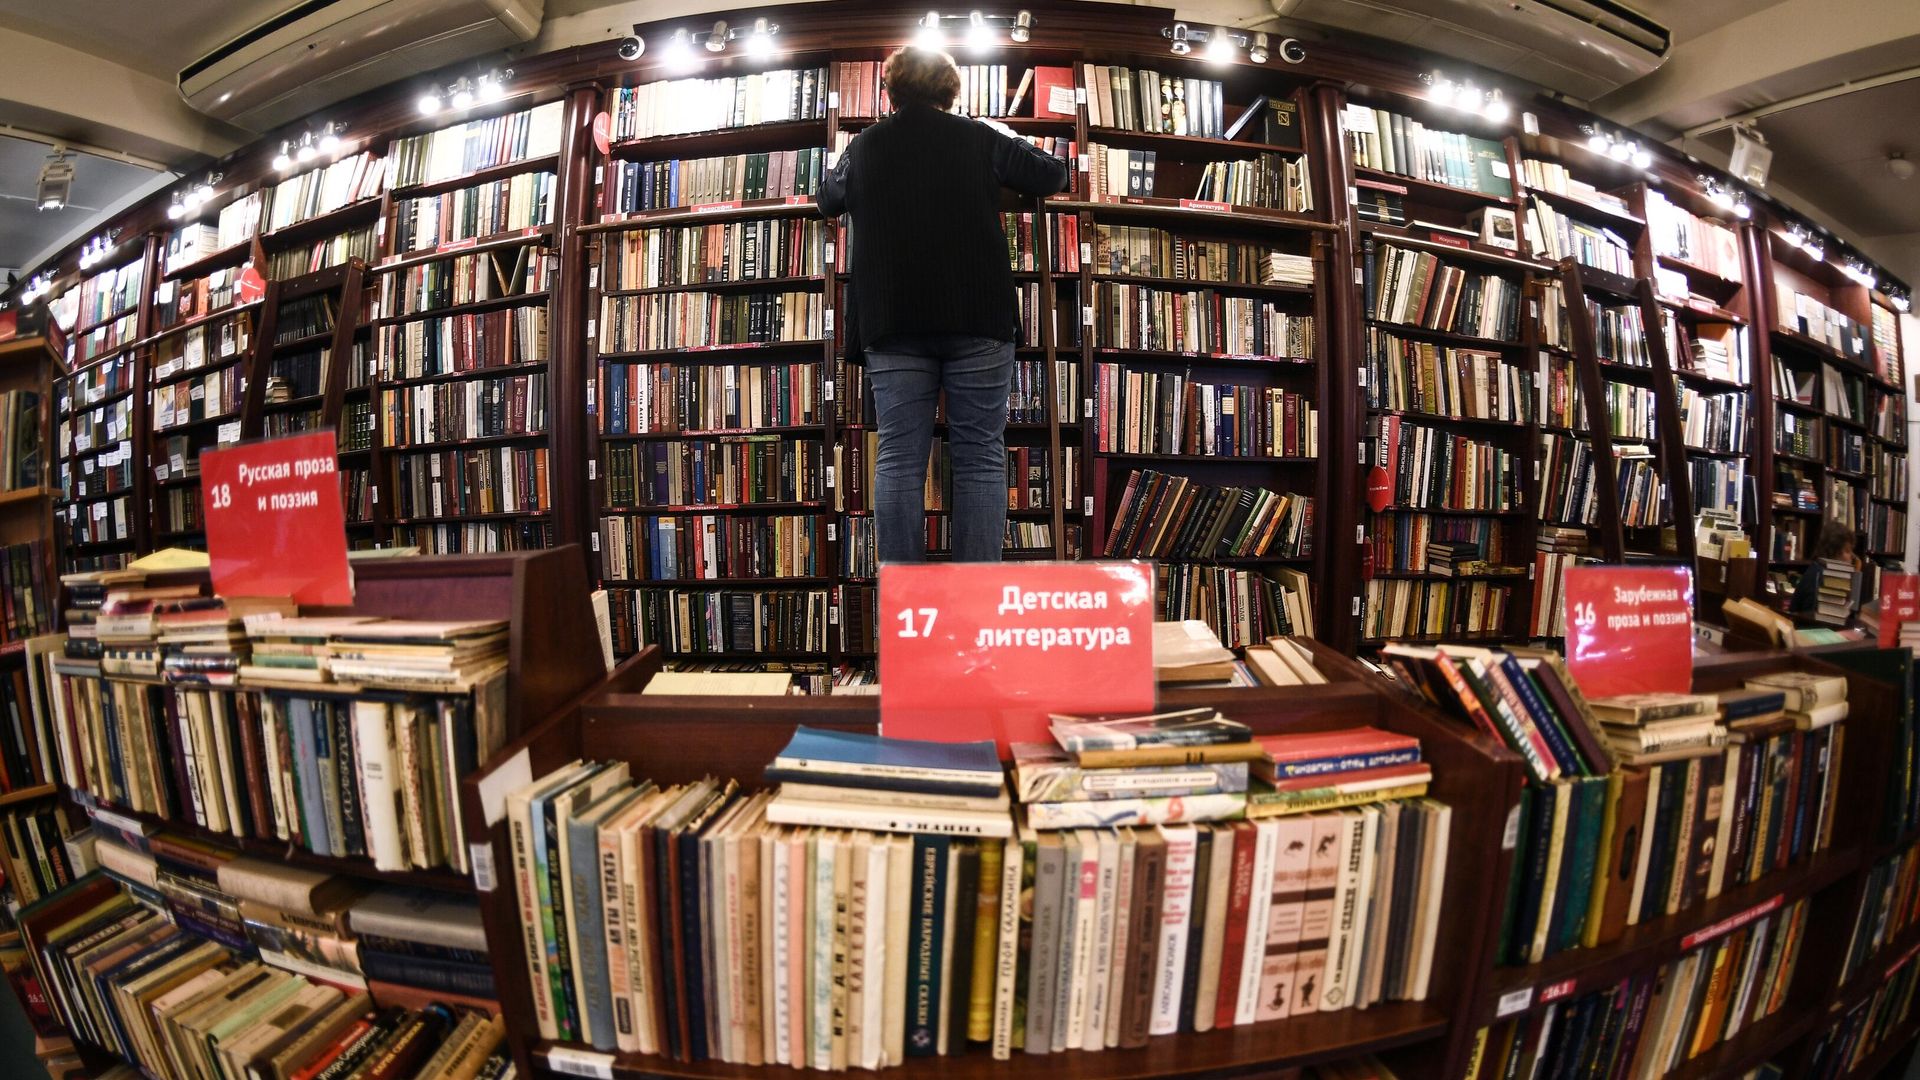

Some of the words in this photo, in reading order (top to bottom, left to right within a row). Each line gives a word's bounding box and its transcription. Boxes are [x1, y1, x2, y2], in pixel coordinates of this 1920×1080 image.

[238, 461, 290, 486] Русская
[295, 457, 335, 480] проза
[211, 483, 231, 508] 18
[258, 496, 267, 511] и
[271, 490, 318, 510] поэзия
[997, 586, 1108, 615] Детская
[1614, 586, 1678, 605] Зарубежная
[897, 608, 938, 637] 17
[1574, 602, 1596, 626] 16
[1608, 613, 1640, 631] проза
[1643, 615, 1651, 626] и
[1653, 612, 1687, 625] поэзия
[976, 627, 1131, 650] литература
[922, 847, 937, 915] ЕВРЕЙСКИЕ
[1000, 864, 1022, 934] САЛАМИНА
[918, 918, 933, 982] НАРОДНЫЕ
[1164, 932, 1179, 968] ВОЛКОВ
[917, 984, 929, 1025] СКАЗКИ
[1159, 969, 1175, 1015] АЛЕКСАНДР
